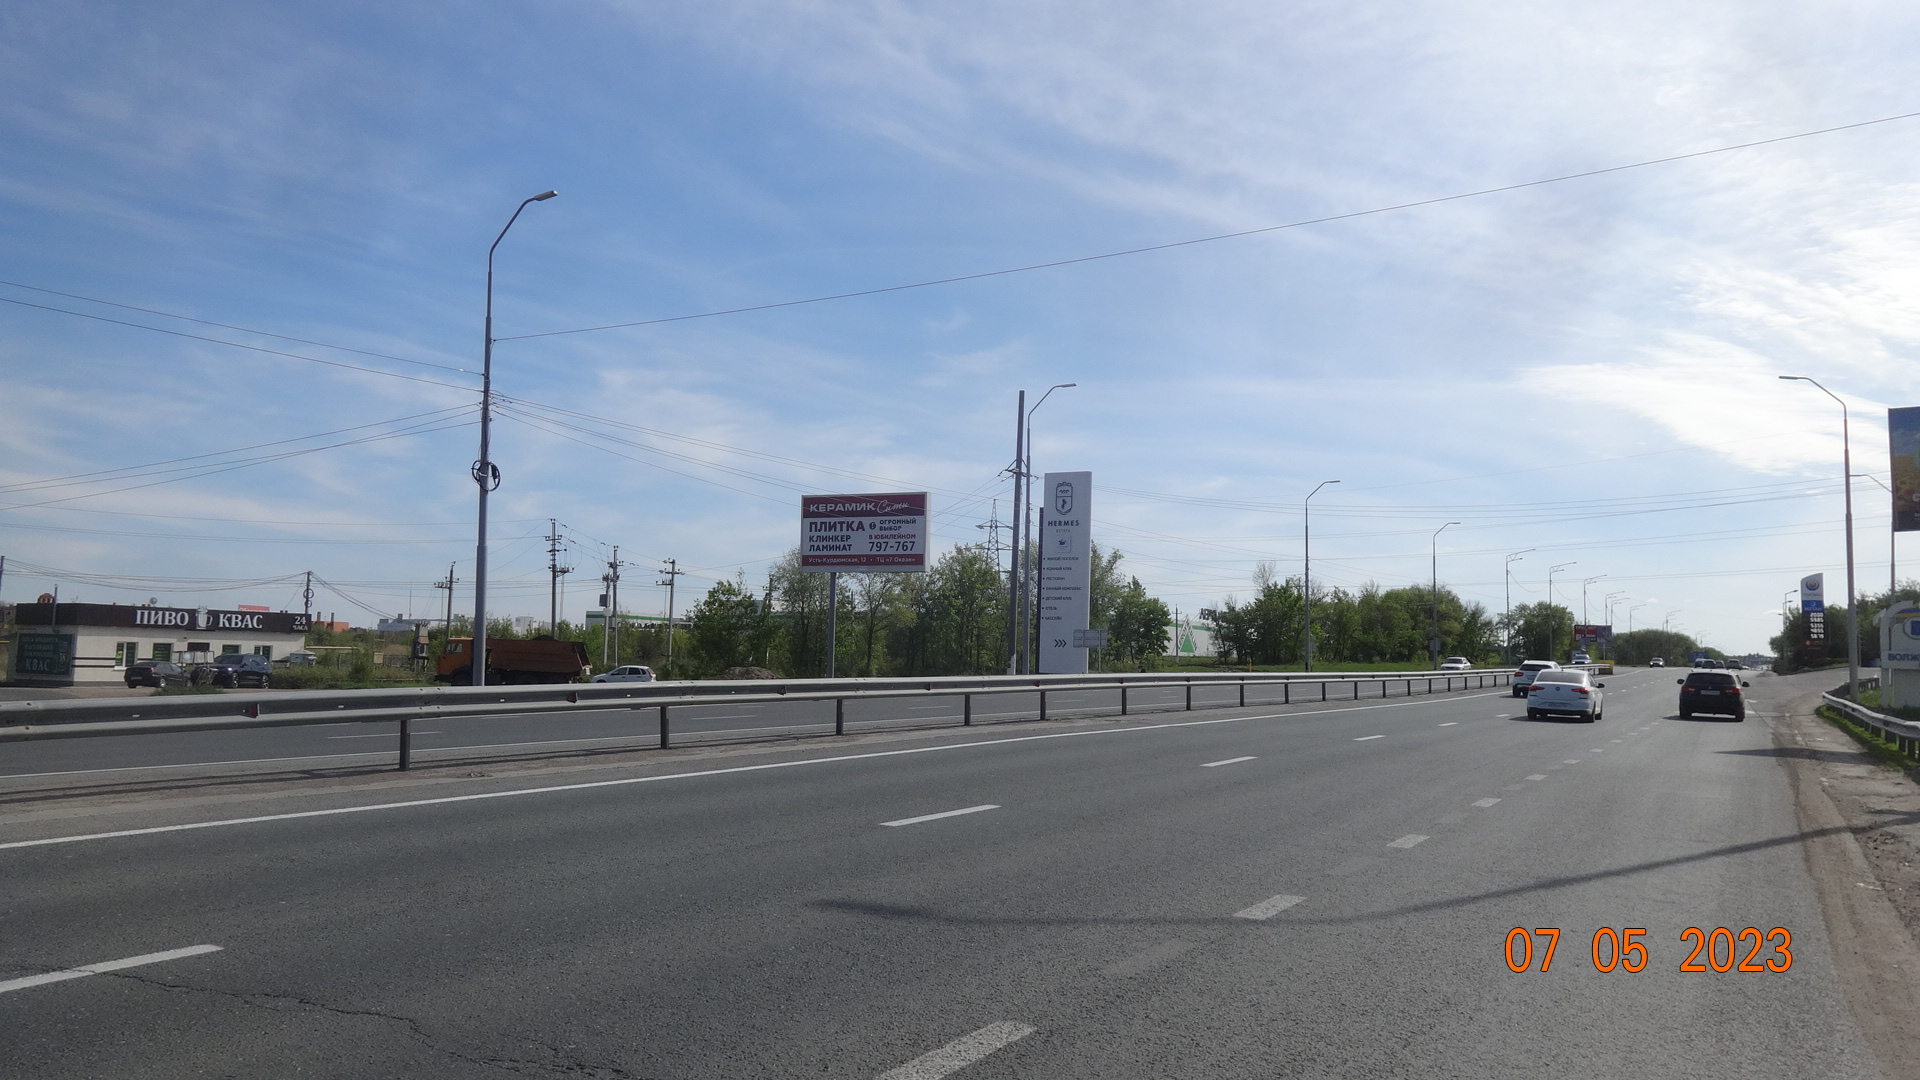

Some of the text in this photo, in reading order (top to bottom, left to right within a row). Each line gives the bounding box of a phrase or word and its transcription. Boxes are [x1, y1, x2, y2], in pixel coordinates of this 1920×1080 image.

[809, 499, 910, 514] КЕРАМИК Сити
[879, 517, 917, 525] ОГРОМНЫЙ
[809, 521, 865, 533] ПЛИТКА
[808, 534, 851, 543] КЛИНКЕР
[808, 544, 852, 552] ЛАМИНАТ
[868, 541, 916, 552] 797-767
[135, 609, 189, 626] ПИВО
[218, 613, 263, 629] КВАС
[294, 616, 306, 625] 24
[25, 658, 51, 671] КВАС
